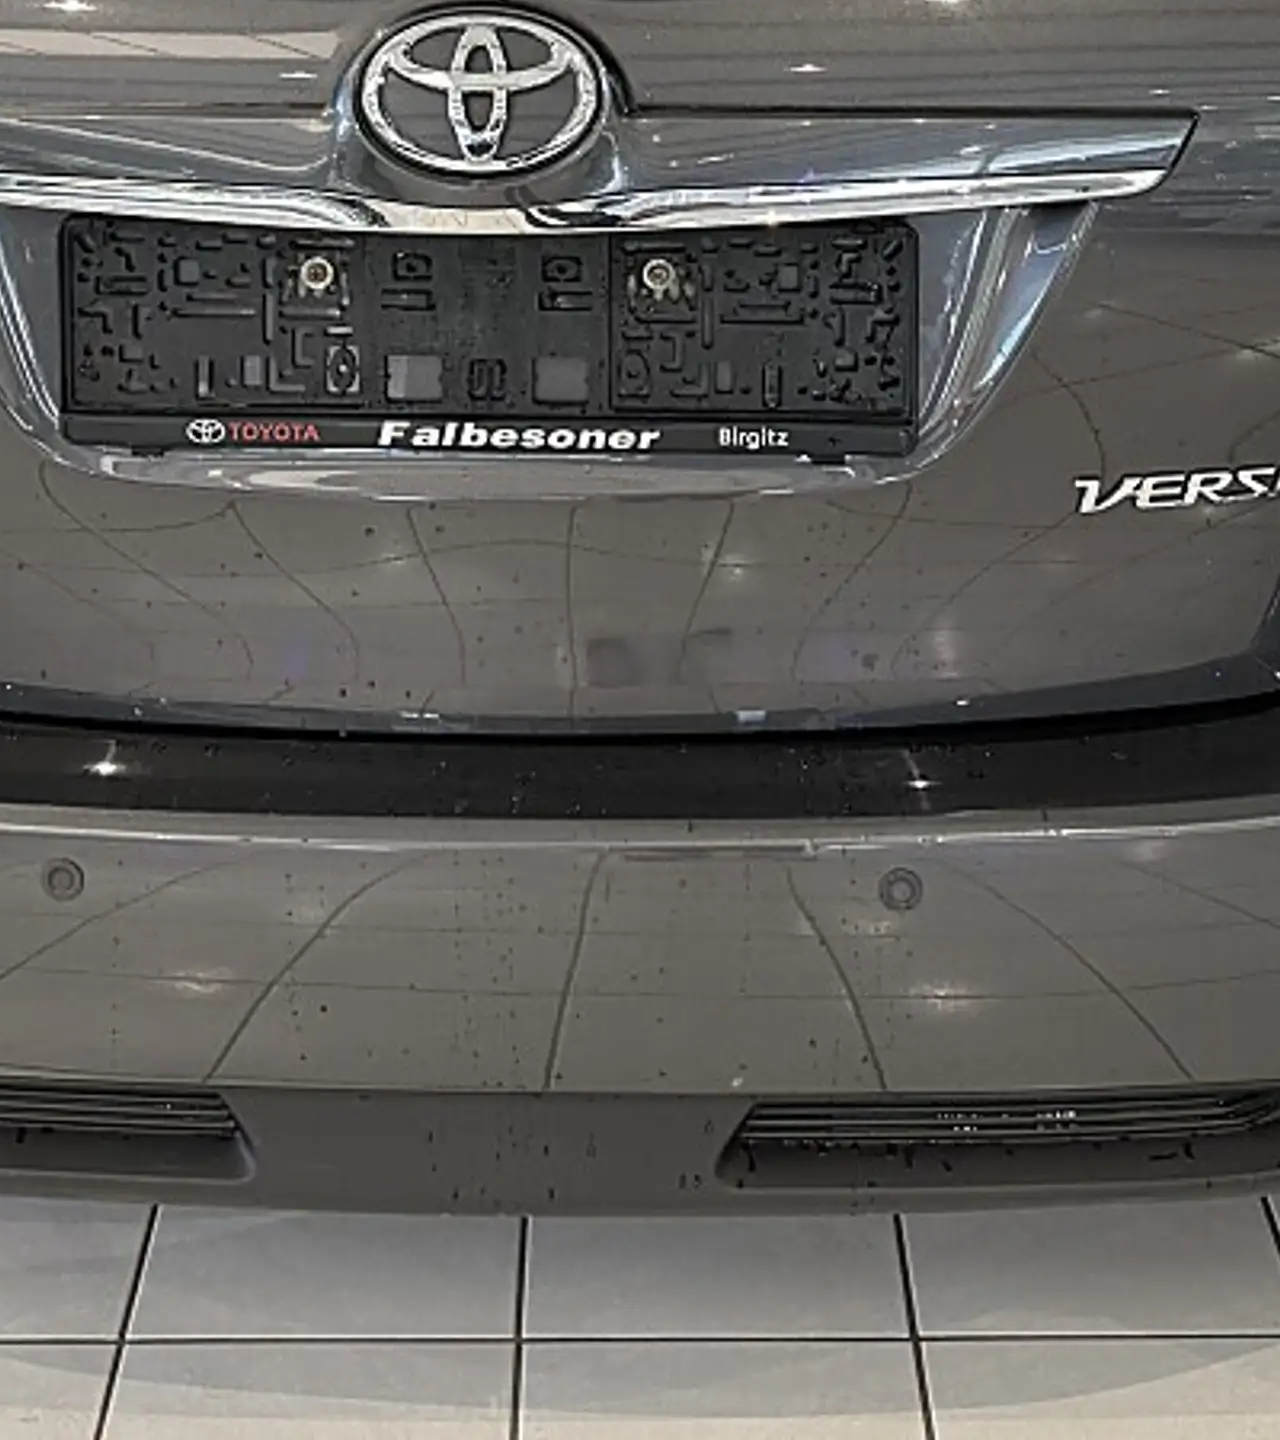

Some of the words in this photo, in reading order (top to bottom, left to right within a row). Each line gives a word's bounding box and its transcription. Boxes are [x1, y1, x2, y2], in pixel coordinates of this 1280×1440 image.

[229, 423, 319, 442] TOYOTA
[377, 419, 661, 451] Falbesoner
[719, 428, 789, 450] Birgitz
